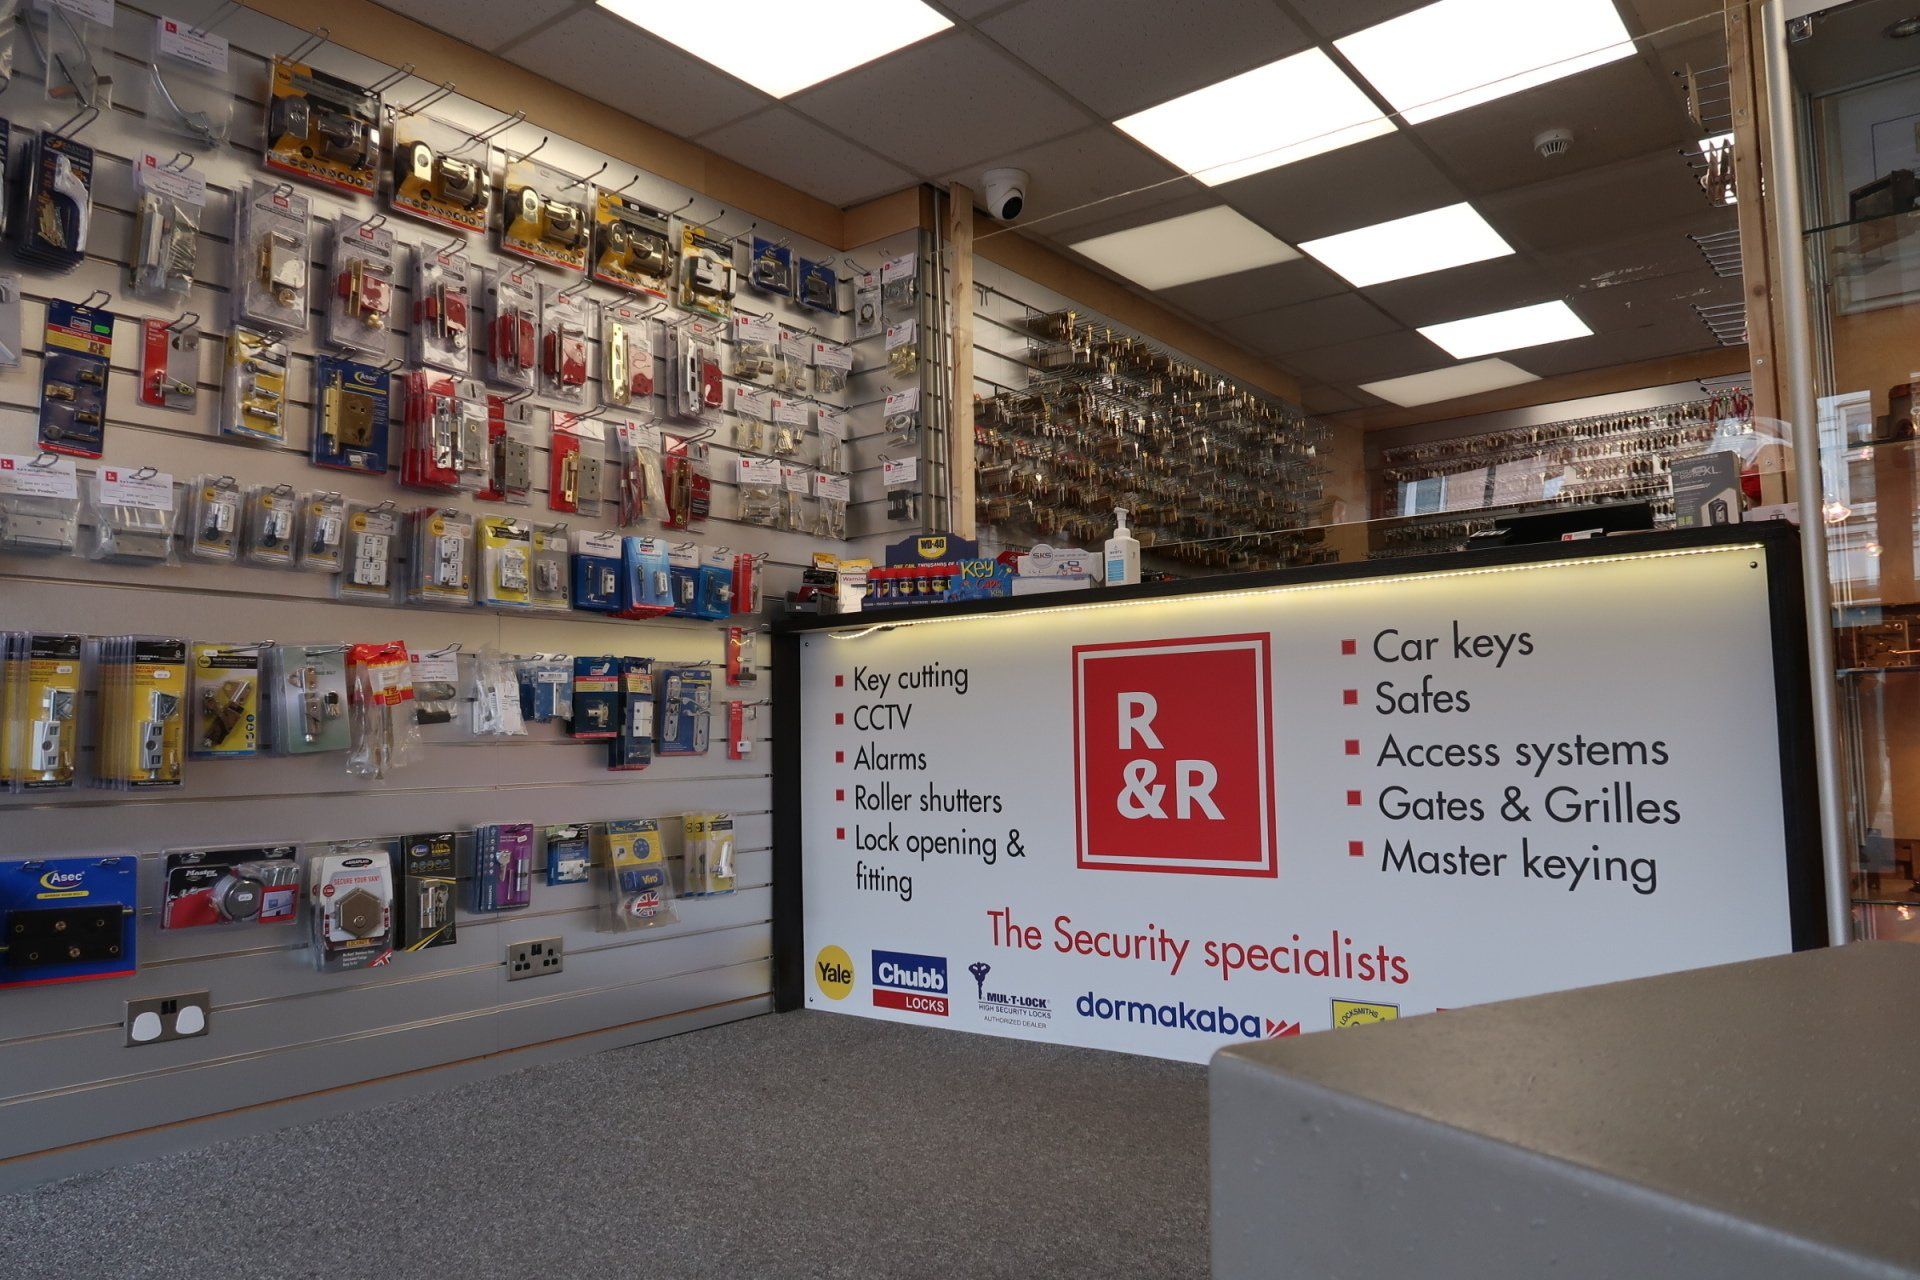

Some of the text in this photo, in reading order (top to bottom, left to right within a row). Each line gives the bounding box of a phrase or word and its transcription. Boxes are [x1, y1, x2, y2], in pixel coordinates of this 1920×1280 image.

[920, 539, 944, 549] WD-40
[1373, 620, 1534, 668] Car keys
[854, 662, 969, 698] Key cutting
[1375, 674, 1471, 715] Safes
[854, 703, 912, 731] CCTV
[1117, 691, 1165, 750] R
[854, 743, 927, 771] Alarms
[1376, 733, 1670, 778] Access systems
[854, 781, 1003, 813] Roller shutters
[1378, 781, 1681, 825] Gates & Grilles
[855, 822, 1026, 865] Lock opening &
[51, 872, 83, 884] Asec
[856, 861, 913, 902] fitting
[1380, 837, 1658, 895] Master keying
[986, 906, 1410, 985] The Security specialists
[818, 961, 852, 984] Yale
[878, 961, 944, 991] Chubb
[905, 996, 945, 1014] LOCKS
[978, 1003, 1052, 1019] HIGH SECURITY LOCKS
[1076, 991, 1262, 1038] dormakaba
[1339, 1006, 1379, 1026] LOCKSMITHS
[1022, 1020, 1047, 1029] DEALER
